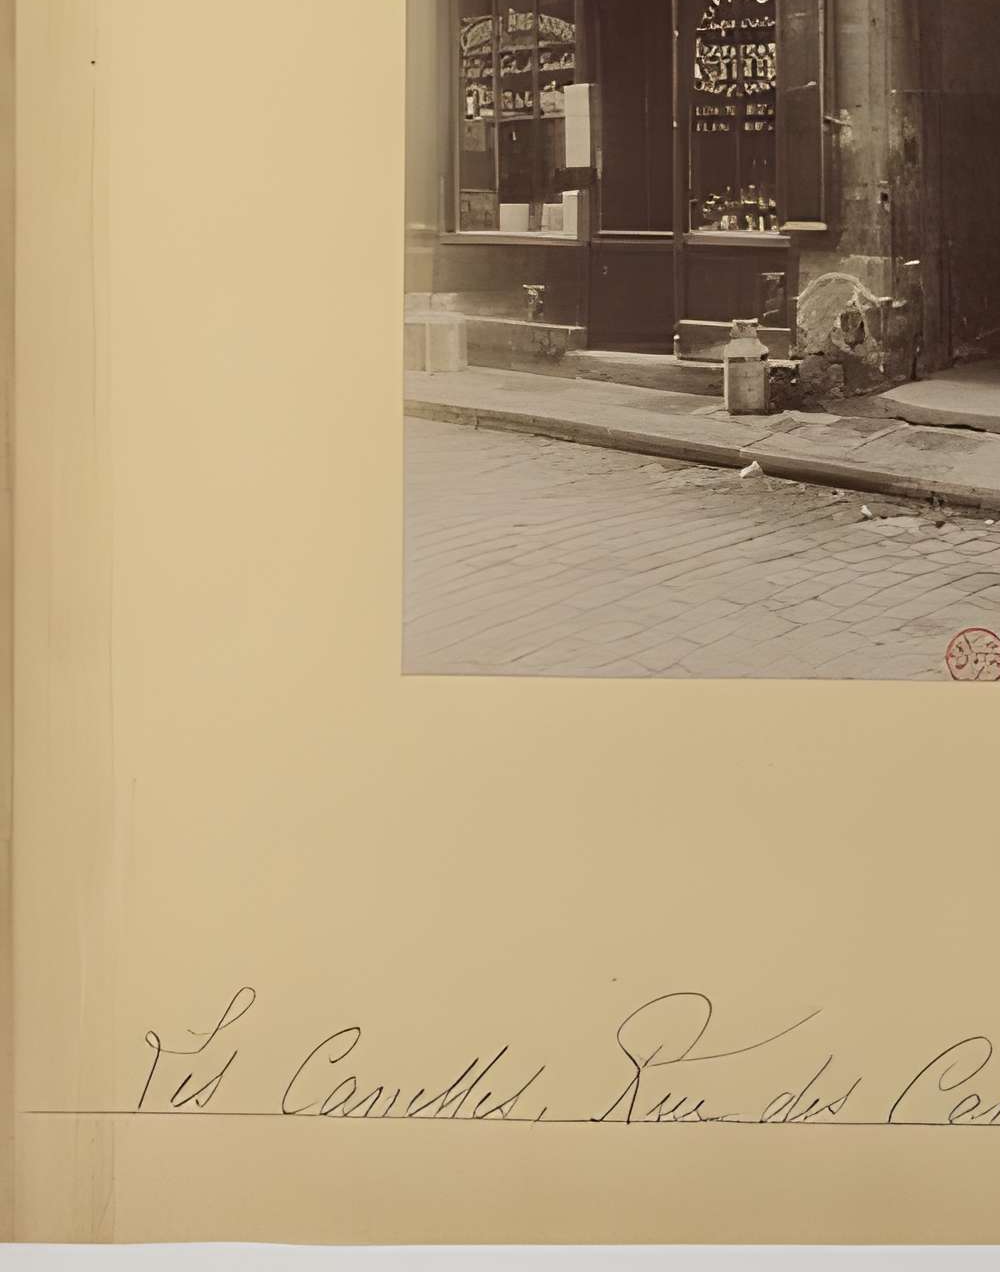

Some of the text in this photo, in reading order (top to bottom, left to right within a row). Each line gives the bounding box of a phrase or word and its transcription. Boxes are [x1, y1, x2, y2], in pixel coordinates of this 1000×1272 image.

[137, 986, 257, 1114] Les
[589, 991, 823, 1124] Rue
[760, 1053, 863, 1125] des
